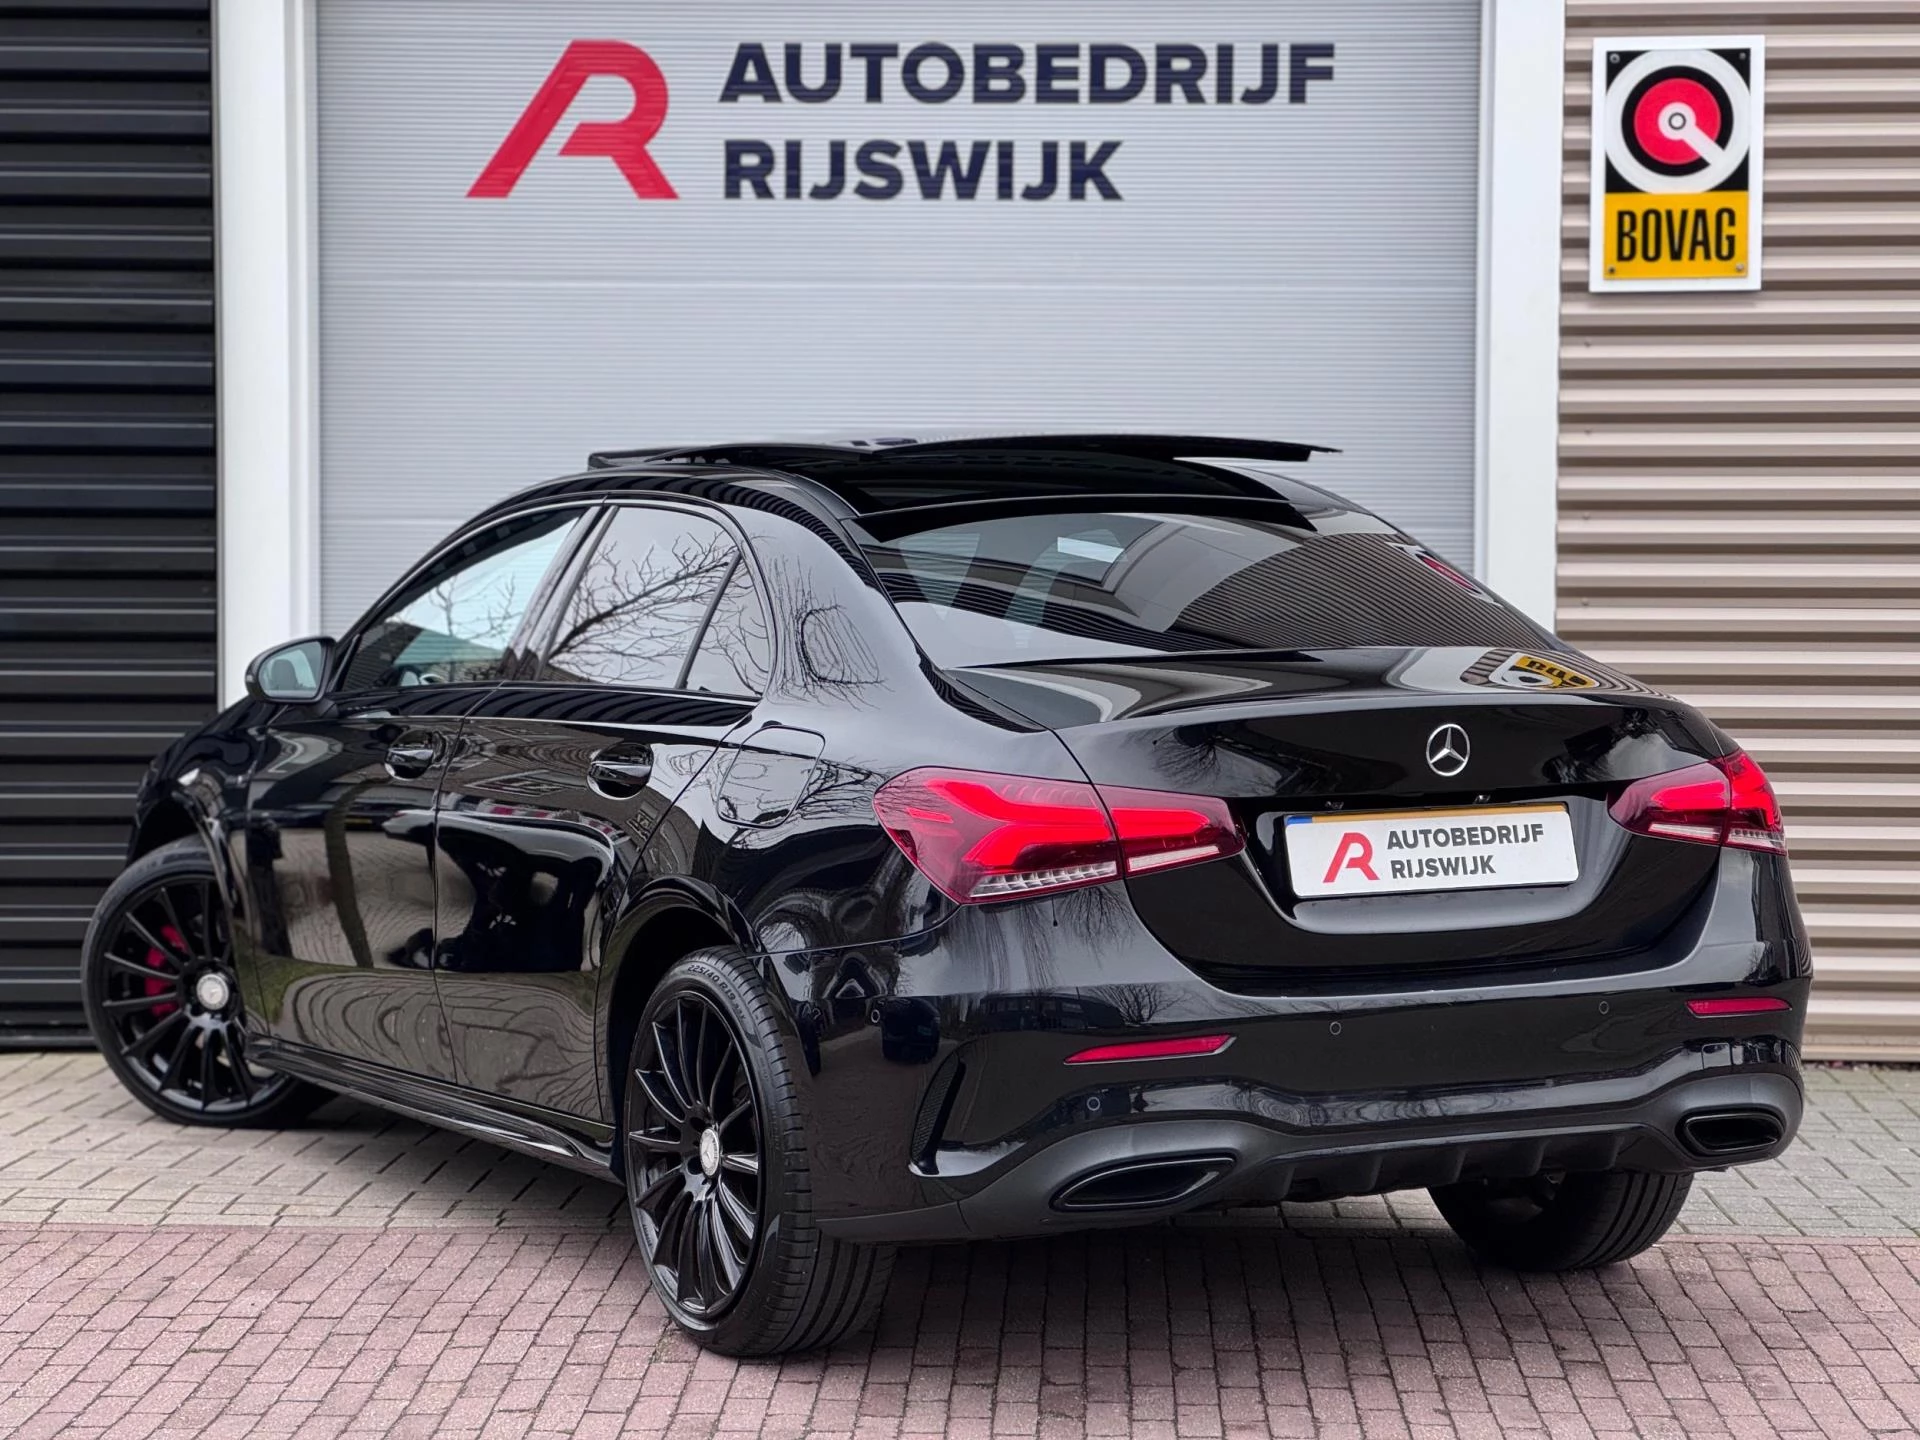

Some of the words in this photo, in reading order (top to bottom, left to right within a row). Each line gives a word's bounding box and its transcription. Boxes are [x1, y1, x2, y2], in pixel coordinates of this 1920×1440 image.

[719, 42, 1335, 104] AUTOBEDRIJF
[723, 139, 1123, 201] RIJSWIJK
[1617, 207, 1736, 262] BOVAG
[1387, 823, 1544, 849] AUTOBEDRIJF
[1390, 855, 1496, 879] RIJSWIJK
[687, 964, 720, 982] 225/40
